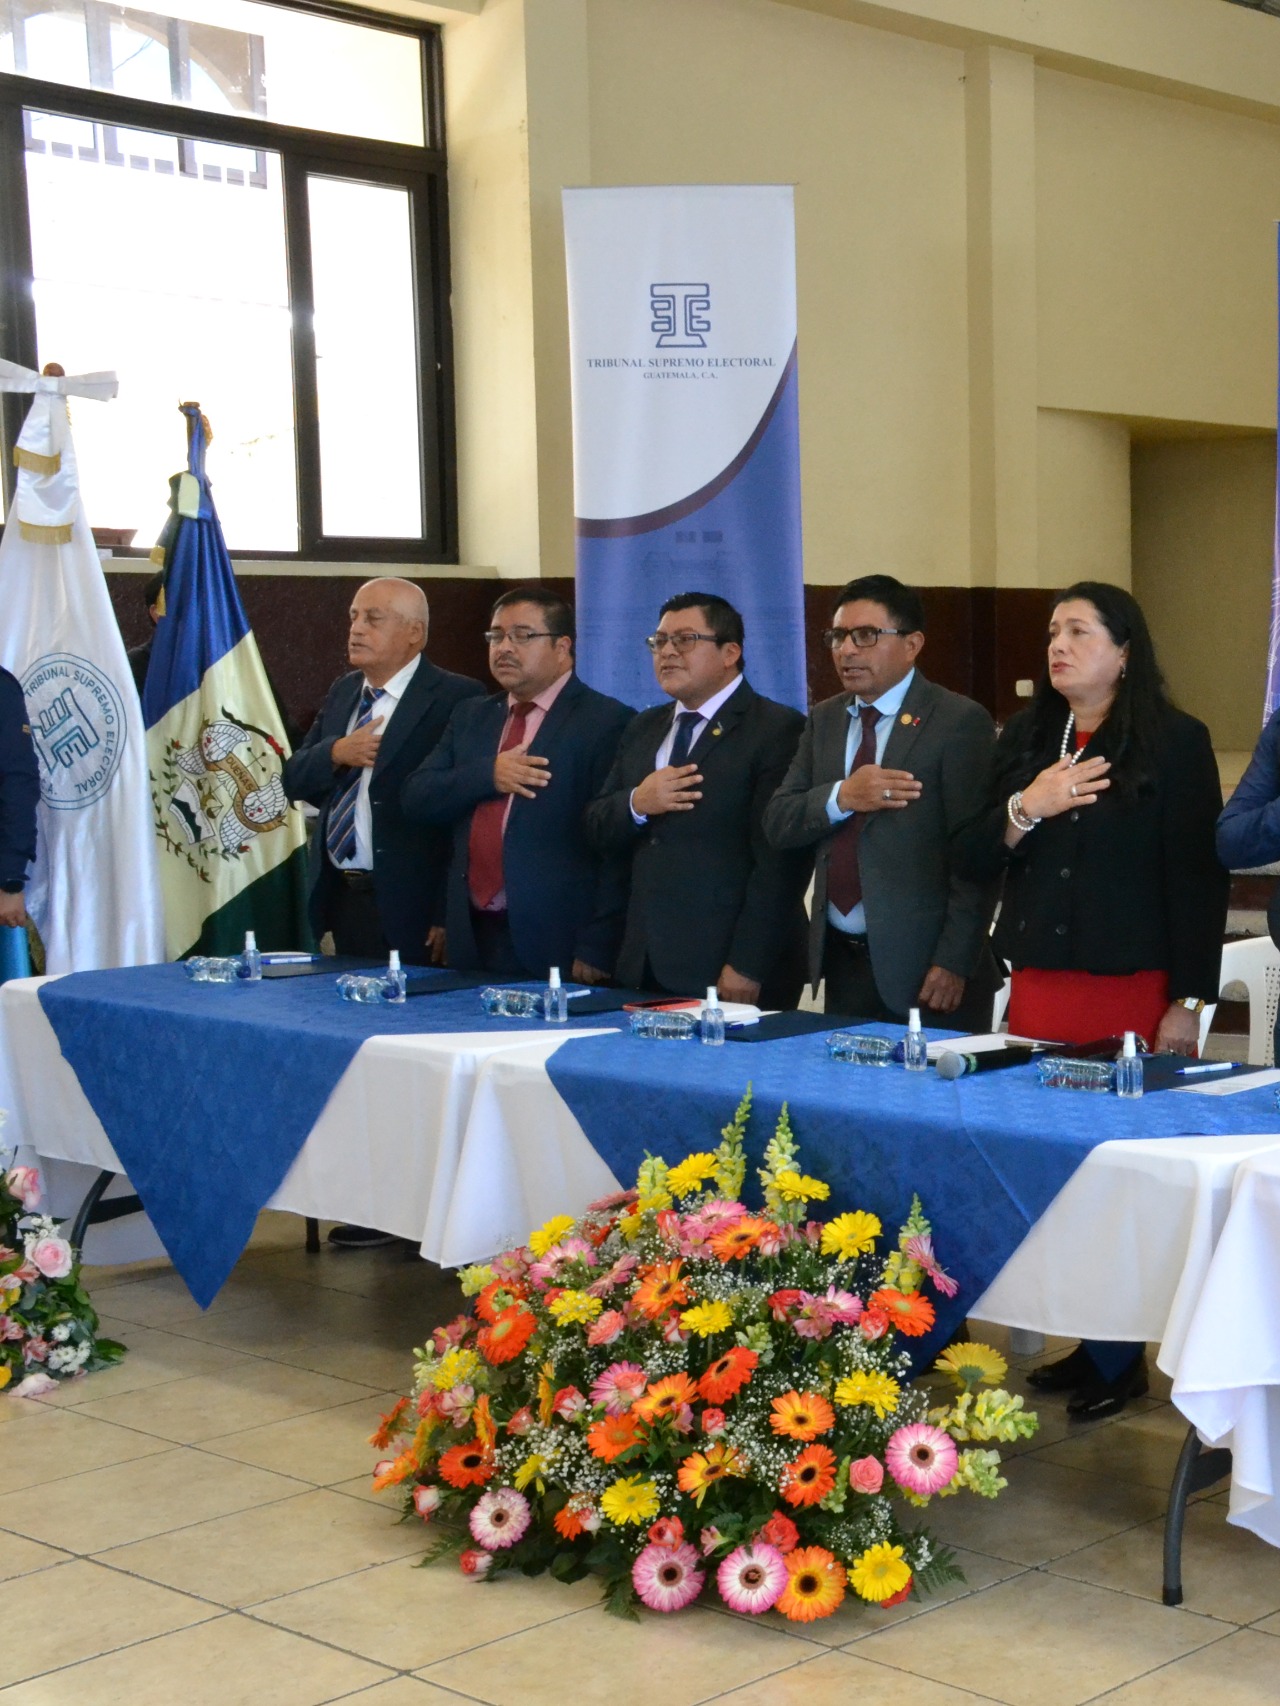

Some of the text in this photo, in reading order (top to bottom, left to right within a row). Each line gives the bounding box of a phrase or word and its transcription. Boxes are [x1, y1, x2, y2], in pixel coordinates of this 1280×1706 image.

[587, 357, 777, 368] TRIBUNAL SUPREMO ELECTORAL
[643, 372, 718, 380] GUATEMALA, C.A.
[25, 665, 115, 795] TRIBUNAL SUPREMO ELECTORAL
